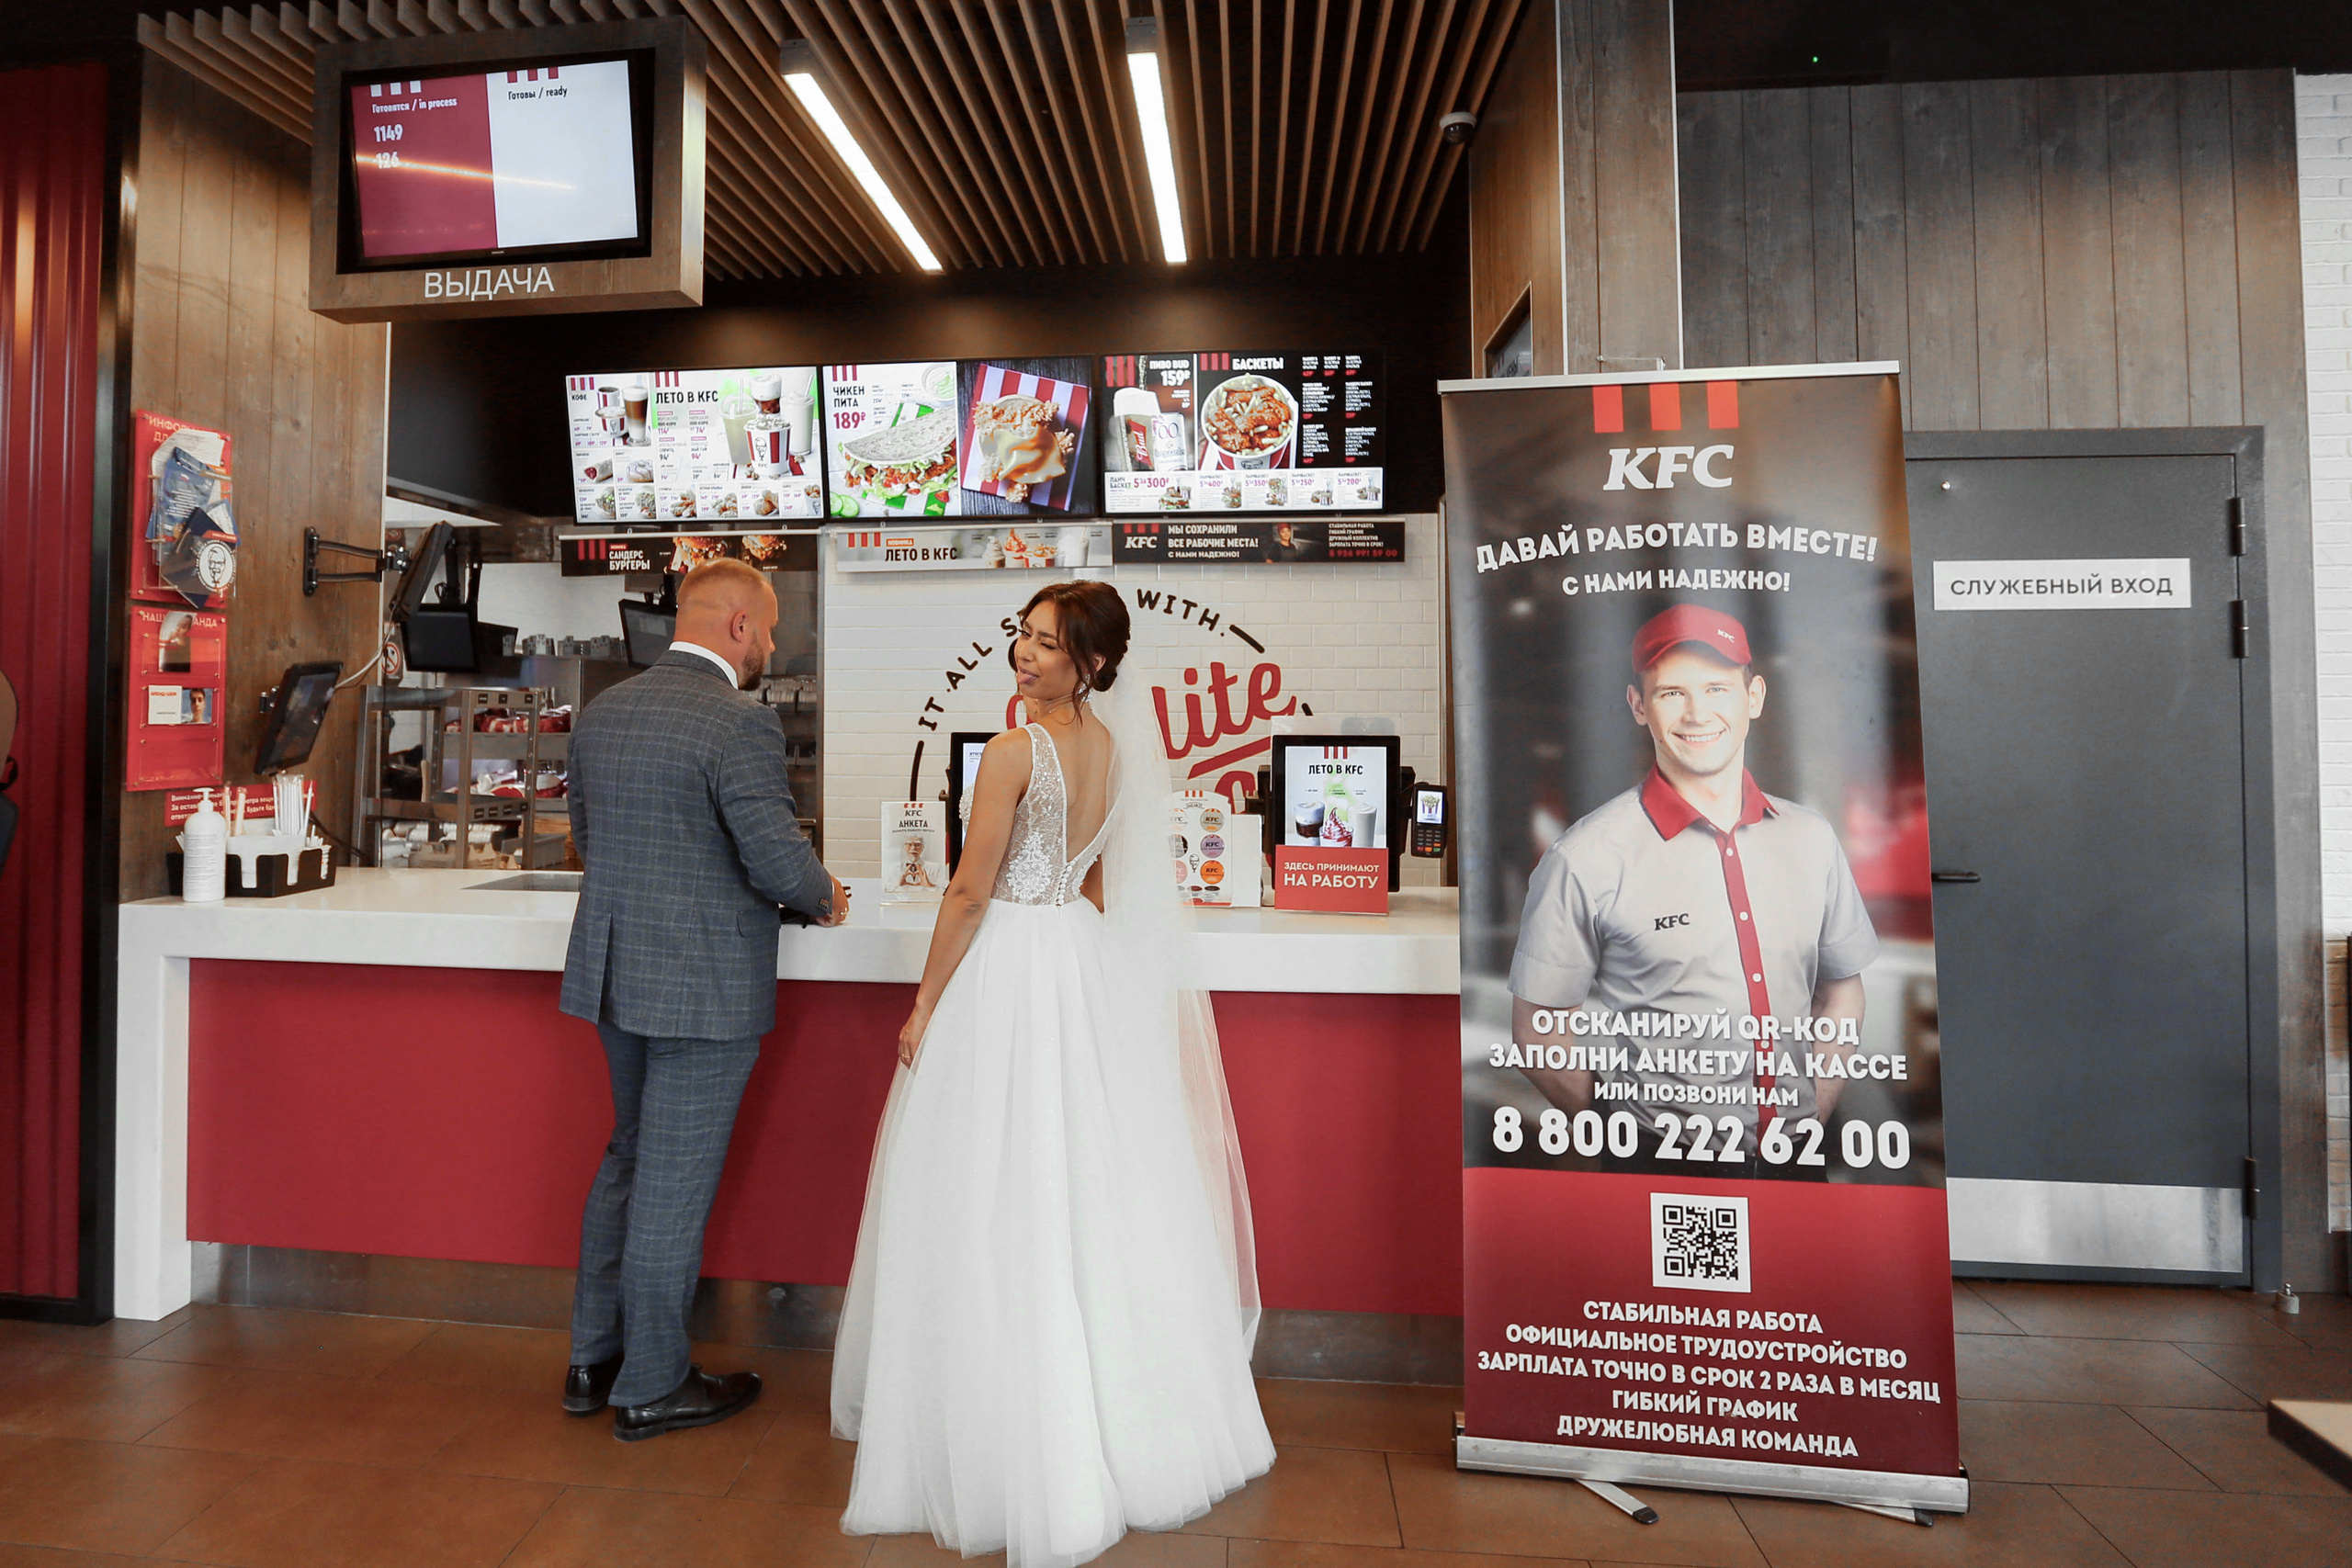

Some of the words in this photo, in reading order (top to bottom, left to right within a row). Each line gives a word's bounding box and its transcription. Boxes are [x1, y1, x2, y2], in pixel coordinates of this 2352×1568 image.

[508, 90, 536, 100] Готовы
[546, 86, 568, 99] ready
[372, 103, 410, 113] Готовятся
[419, 99, 427, 108] in
[428, 97, 458, 110] process
[374, 124, 403, 141] 1149
[376, 152, 399, 169] 126
[424, 267, 555, 301] ВЫДАЧА
[1149, 361, 1171, 369] ПИВО
[1172, 359, 1190, 368] BUD
[1232, 357, 1284, 370] БАСКЕТЫ
[656, 392, 684, 404] ЛЕТО
[687, 391, 695, 402] В
[698, 390, 718, 402] KFC
[833, 386, 865, 396] ЧИКЕН
[834, 398, 858, 408] ПИТА
[1603, 445, 1735, 491] KFC
[1168, 525, 1182, 534] МЫ
[1185, 525, 1238, 534] СОХРАНИЛИ
[1125, 536, 1158, 548] KFC
[1168, 539, 1184, 547] ВСЕ
[1186, 538, 1224, 547] РАБОЧИЕ
[1227, 538, 1259, 547] МЕСТА!
[1476, 525, 1579, 573] ДАВАЙ
[1587, 523, 1738, 553] РАБОТАТЬ
[1747, 524, 1877, 562] ВМЕСТЕ!
[609, 550, 643, 560] САНДЕРС
[885, 548, 918, 561] ЛЕТО
[922, 548, 930, 560] В
[933, 547, 957, 560] KFC
[609, 560, 650, 570] БУРГЕРЫ
[1563, 575, 1578, 595] С
[1585, 570, 1652, 593] НАМИ
[1659, 569, 1791, 592] НАДЕЖНО!
[1951, 573, 2102, 595] СЛУЖЕБНЫЙ
[2111, 578, 2173, 596] ВХОД
[1717, 629, 1735, 643] KFC
[1308, 764, 1333, 775] ЛЕТО
[1336, 764, 1342, 774] В
[1345, 764, 1363, 774] KFC
[899, 819, 929, 828] АНКЕТА
[1283, 862, 1315, 871] ЗДЕСЬ
[1317, 863, 1380, 874] ПРИНИМАЮТ
[1283, 874, 1308, 886] НА
[1312, 874, 1379, 889] РАБОТУ
[1654, 912, 1690, 931] KFC
[1532, 1008, 1731, 1040] ОТСКАНИРУЙ
[1738, 1013, 1859, 1044] QR-КОД
[1489, 1043, 1629, 1073] ЗАПОЛНИ
[1635, 1047, 1750, 1076] АНКЕТУ
[1756, 1052, 1798, 1077] НА
[1806, 1053, 1907, 1080] КАССЕ
[1593, 1082, 1638, 1101] ИЛИ
[1644, 1084, 1747, 1104] ПОЗВОНИ
[1751, 1087, 1798, 1106] НАМ
[1493, 1106, 1524, 1153] 8
[1538, 1109, 1638, 1157] 800
[1654, 1113, 1746, 1163] 222
[1760, 1117, 1826, 1167] 62
[1840, 1120, 1910, 1169] 00
[1583, 1301, 1730, 1329] СТАБИЛЬНАЯ
[1736, 1309, 1823, 1334] РАБОТА
[1506, 1324, 1677, 1353] ОФИЦИАЛЬНОЕ
[1681, 1337, 1906, 1370] ТРУДОУСТРОЙСТВО
[1477, 1351, 1589, 1377] ЗАРПЛАТА
[1592, 1359, 1666, 1382] ТОЧНО
[1672, 1365, 1685, 1383] В
[1691, 1367, 1754, 1390] СРОК
[1759, 1371, 1771, 1390] 2
[1777, 1372, 1835, 1394] РАЗА
[1840, 1377, 1854, 1396] В
[1860, 1378, 1940, 1404] МЕСЯЦ
[1612, 1389, 1702, 1415] ГИБКИЙ
[1707, 1396, 1798, 1423] ГРАФИК
[1557, 1416, 1736, 1449] ДРУЖЕЛЮБНАЯ
[1742, 1429, 1859, 1457] КОМАНДА
